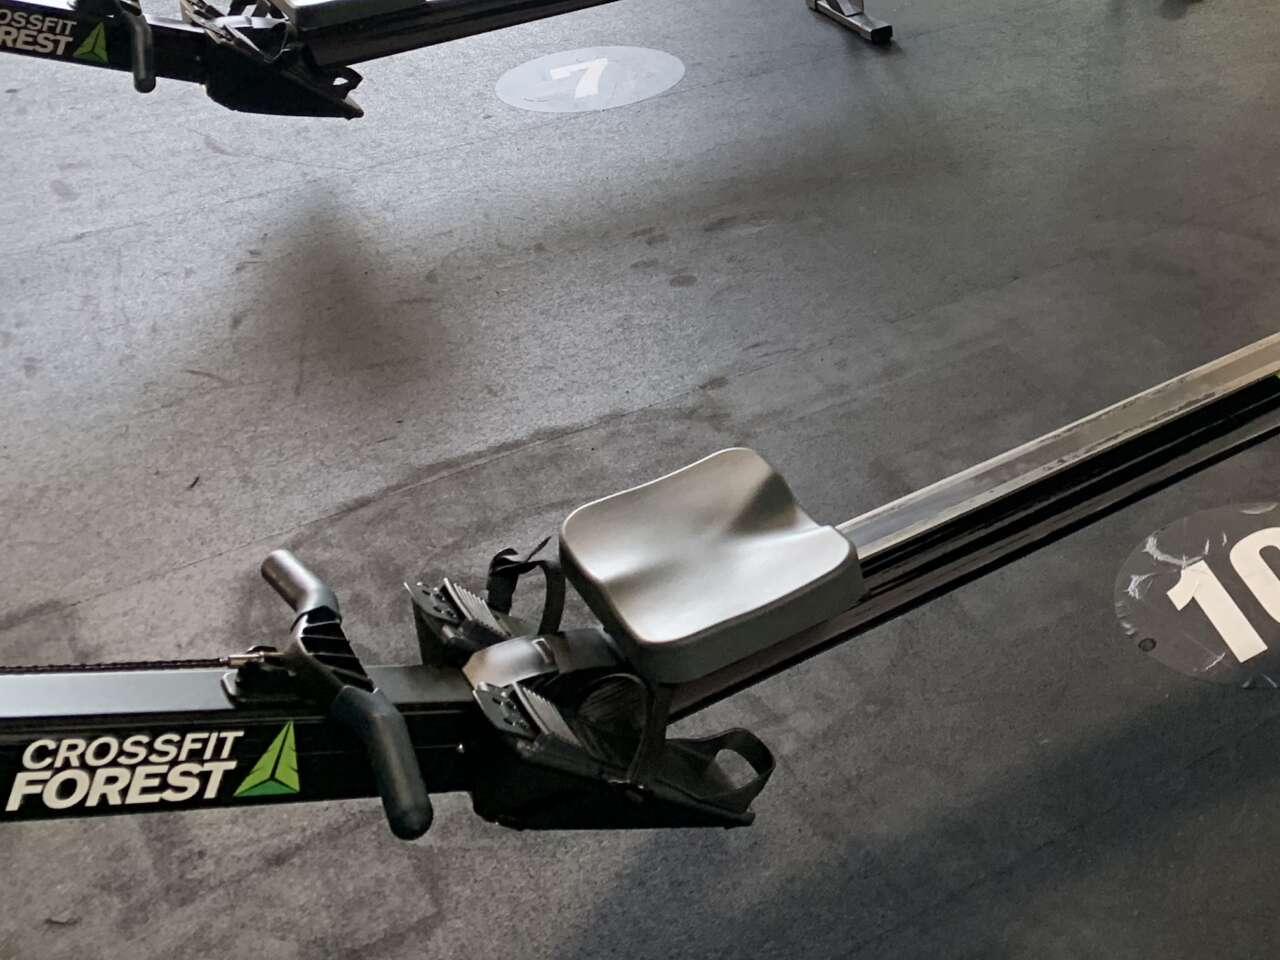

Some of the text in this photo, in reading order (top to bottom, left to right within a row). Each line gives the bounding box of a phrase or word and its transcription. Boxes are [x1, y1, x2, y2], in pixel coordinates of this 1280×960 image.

[550, 58, 608, 98] 7
[22, 731, 244, 769] CROSSFIT
[5, 760, 237, 811] FOREST
